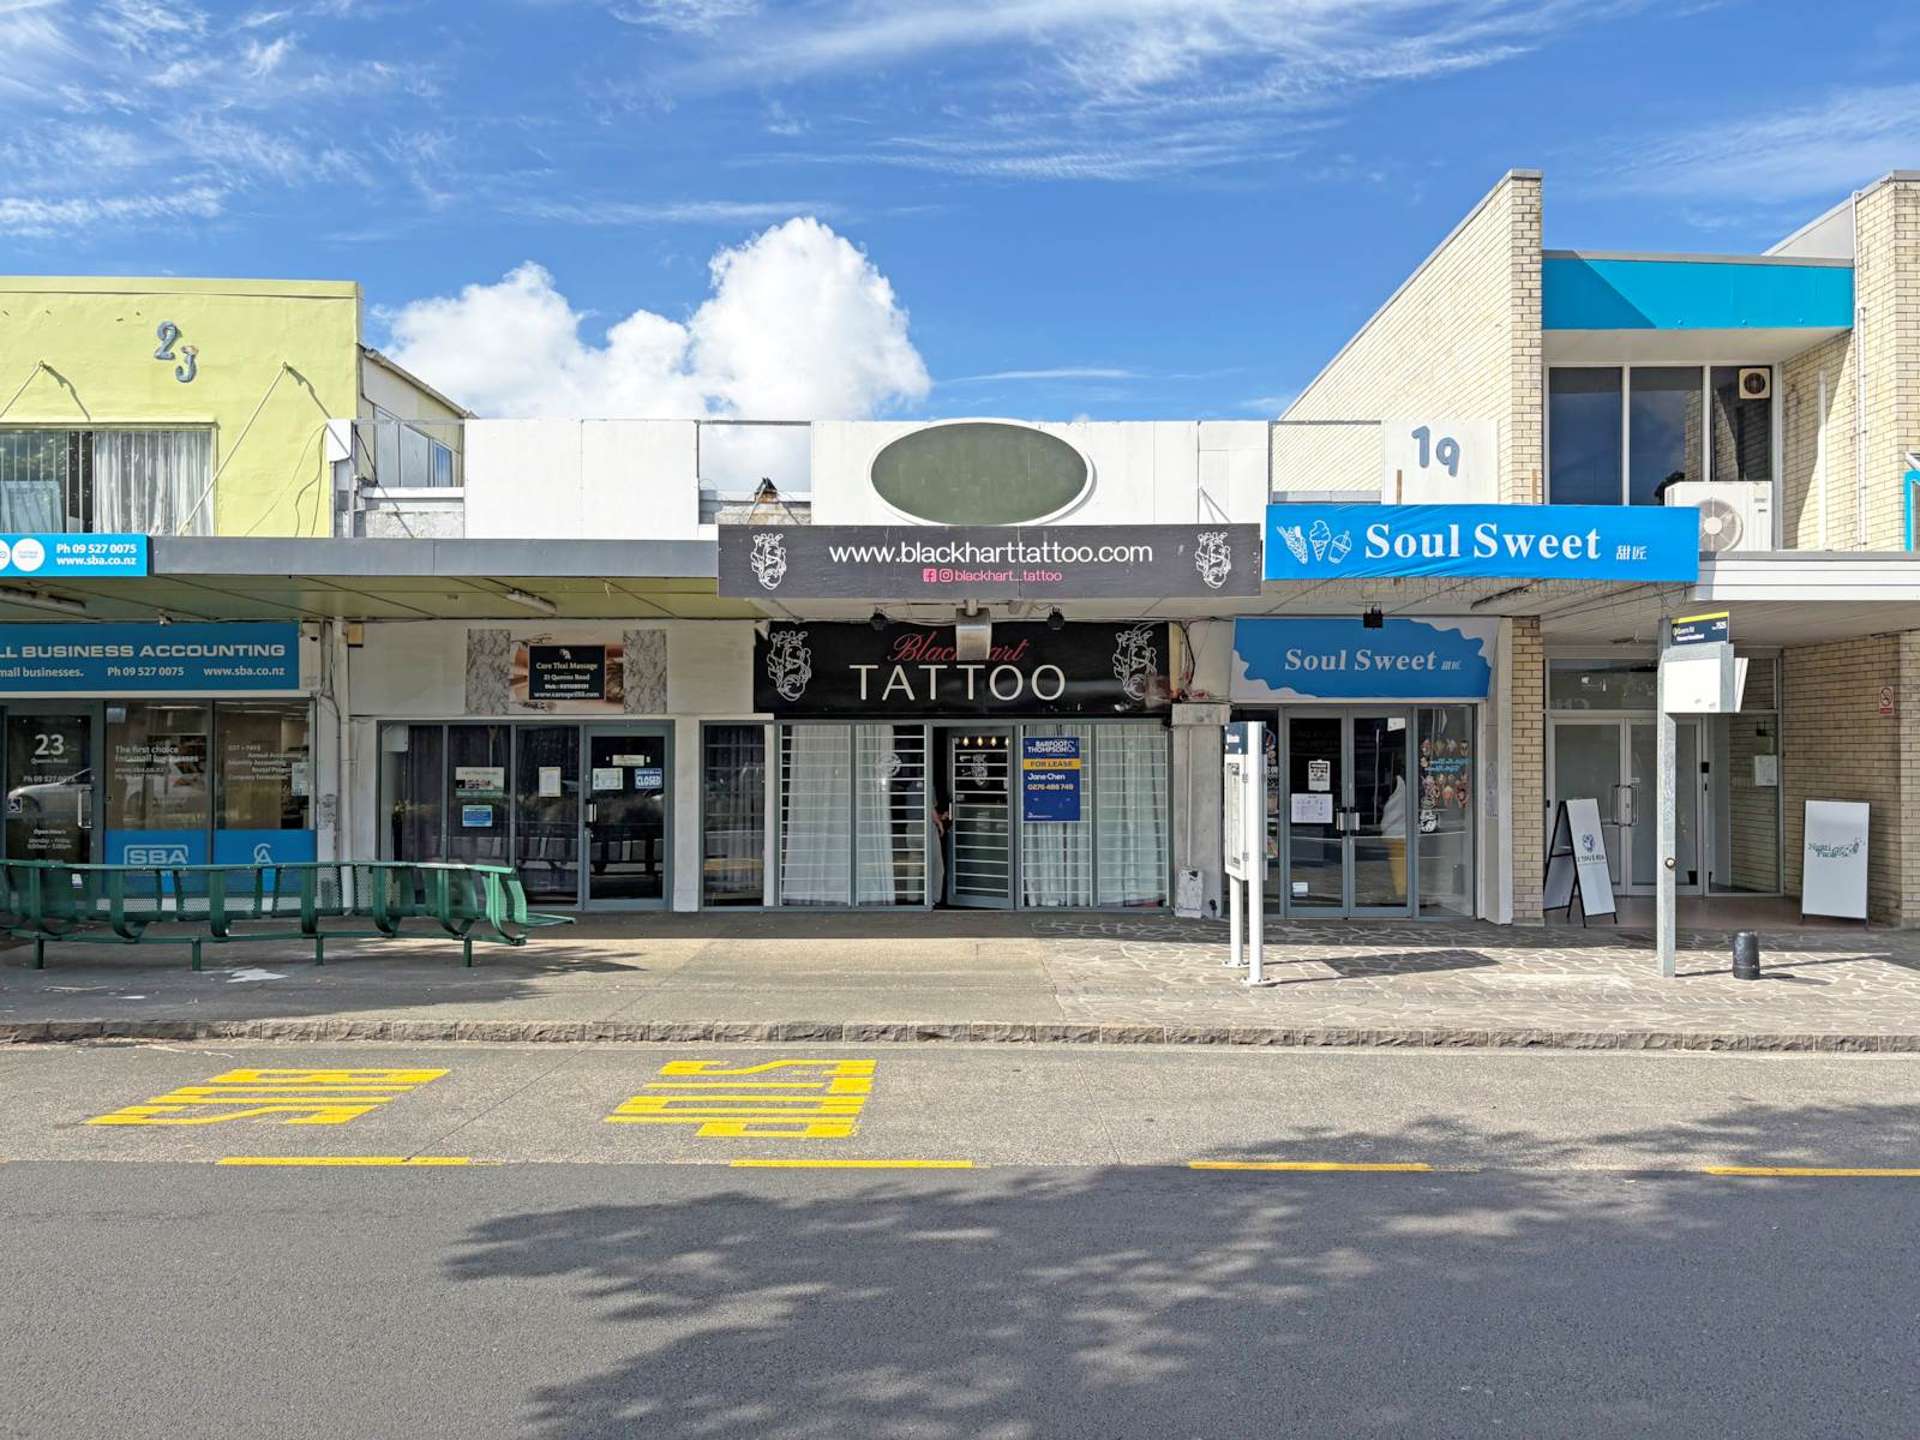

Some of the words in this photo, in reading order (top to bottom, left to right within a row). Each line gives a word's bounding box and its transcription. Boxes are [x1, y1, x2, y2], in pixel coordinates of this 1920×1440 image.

[154, 321, 199, 383] 23
[1411, 425, 1460, 477] 19
[56, 543, 71, 553] Ph
[72, 543, 86, 553] 09
[88, 543, 109, 553] 527
[110, 543, 137, 553] 0075
[1365, 523, 1461, 559] Soul
[1473, 523, 1602, 559] Sweet
[56, 554, 137, 566] www.sba.co.nz
[829, 541, 1153, 563] www.blackharttattoo.com
[21, 645, 134, 658] BUSINESS
[140, 644, 286, 657] ACCOUNTING
[887, 630, 1030, 662] Blacart
[1284, 648, 1347, 671] Soul
[1354, 648, 1437, 671] Sweet
[22, 666, 85, 677] businesses.
[107, 666, 121, 676] Ph
[122, 666, 136, 676] 09
[137, 667, 157, 676] 527
[158, 667, 184, 676] 0075
[203, 666, 286, 676] www.sba.co.nz
[849, 664, 1065, 701] TATTOO
[34, 734, 64, 755] 23
[637, 776, 661, 786] CLOSED
[1047, 773, 1066, 781] Chen
[129, 849, 187, 865] SBA
